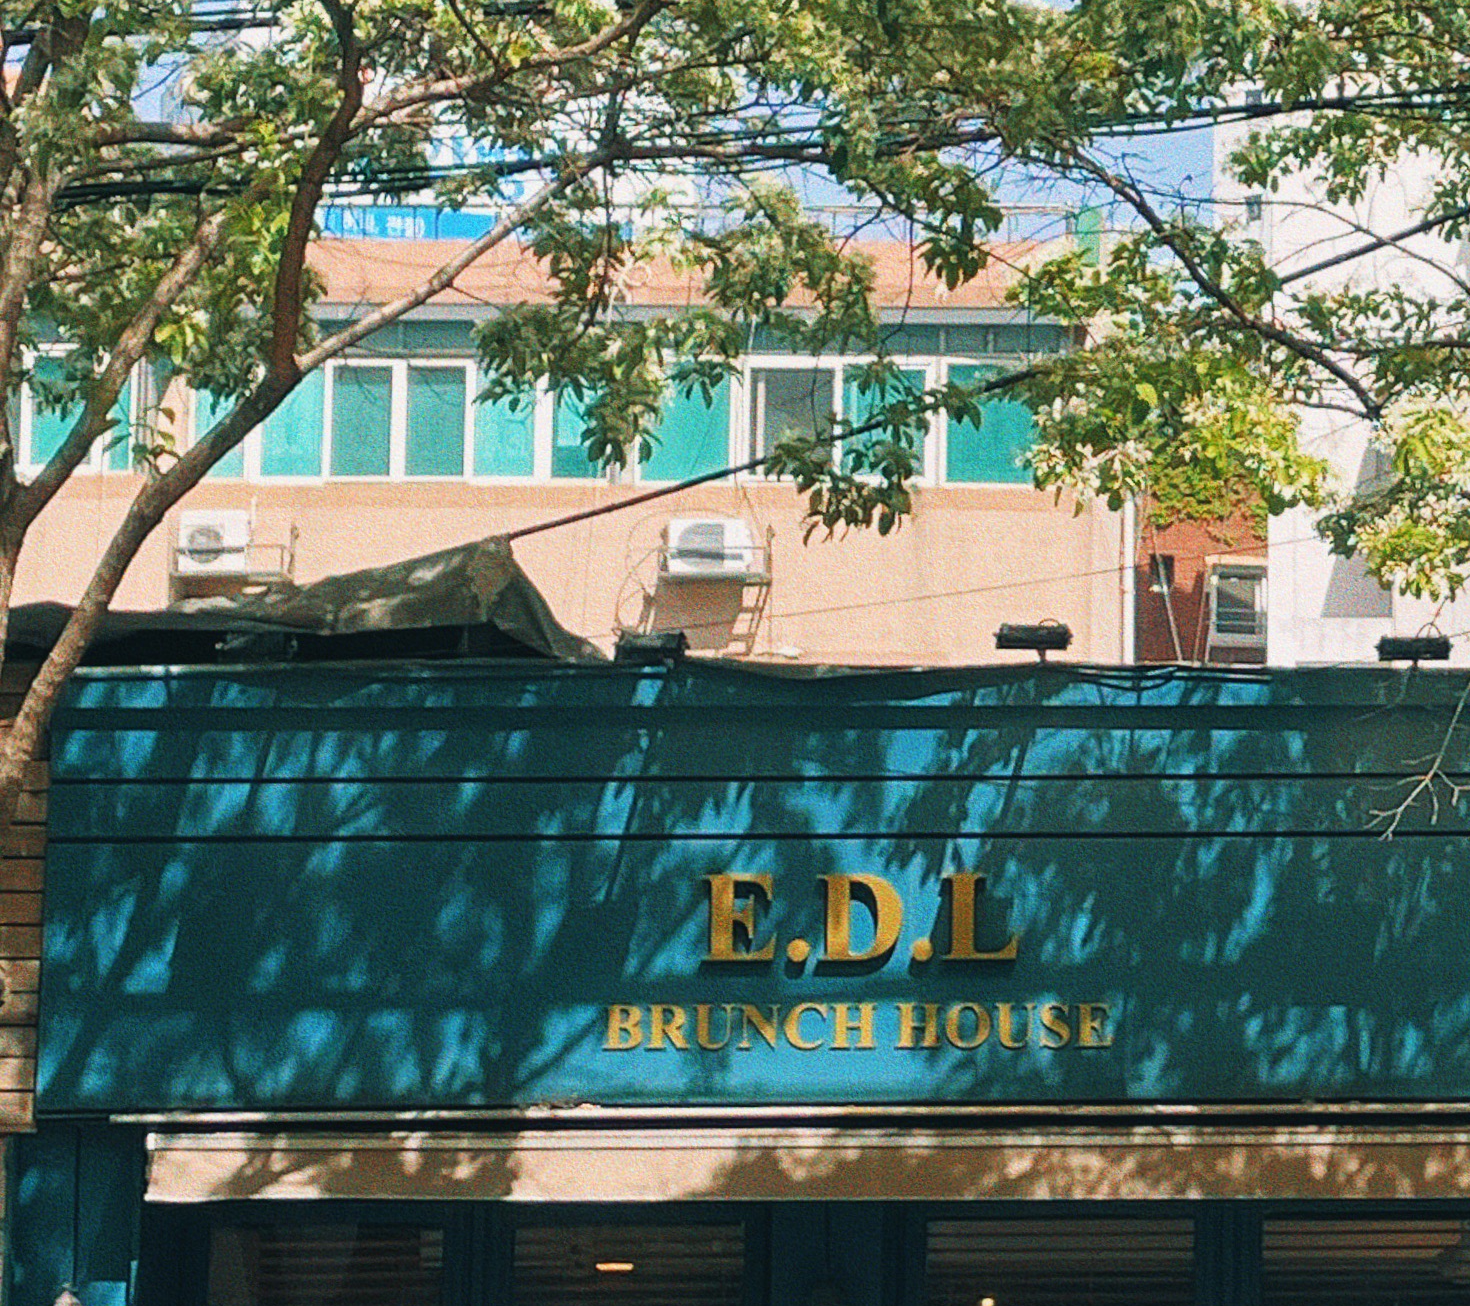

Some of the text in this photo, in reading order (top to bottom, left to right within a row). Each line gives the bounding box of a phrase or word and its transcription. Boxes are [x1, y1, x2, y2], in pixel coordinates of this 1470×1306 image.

[702, 873, 1020, 962] E.D.L
[602, 1001, 1114, 1051] BRUNCH HOUSE
